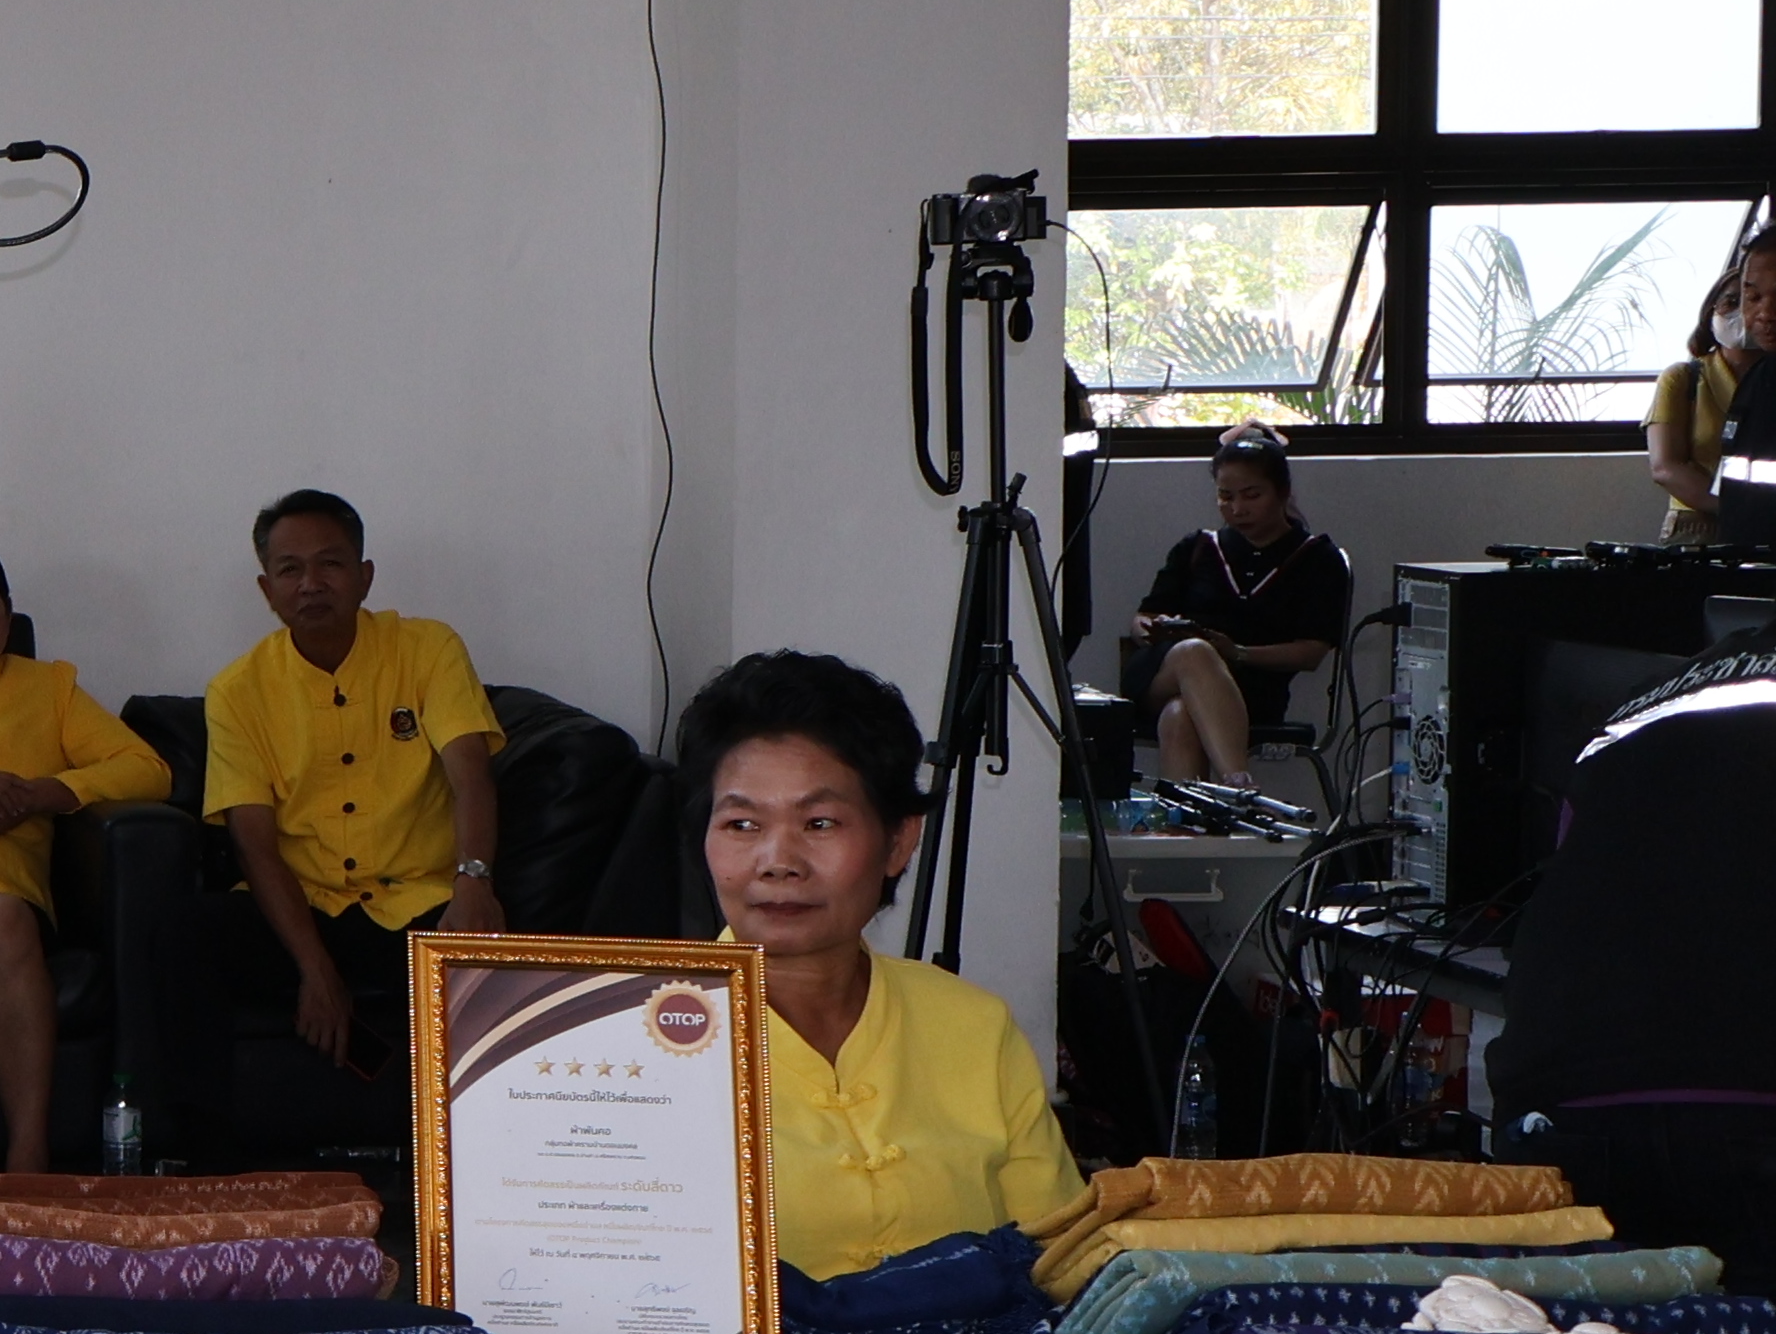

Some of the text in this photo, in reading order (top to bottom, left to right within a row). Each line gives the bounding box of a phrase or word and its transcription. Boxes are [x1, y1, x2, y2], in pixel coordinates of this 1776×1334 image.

[658, 1012, 706, 1026] OTOP
[507, 1087, 673, 1105] ใบประกาศนียบัตรนี้ให้ไว้เพื่อแสดงว่า
[621, 1177, 683, 1193] ระดับสี่ดาว
